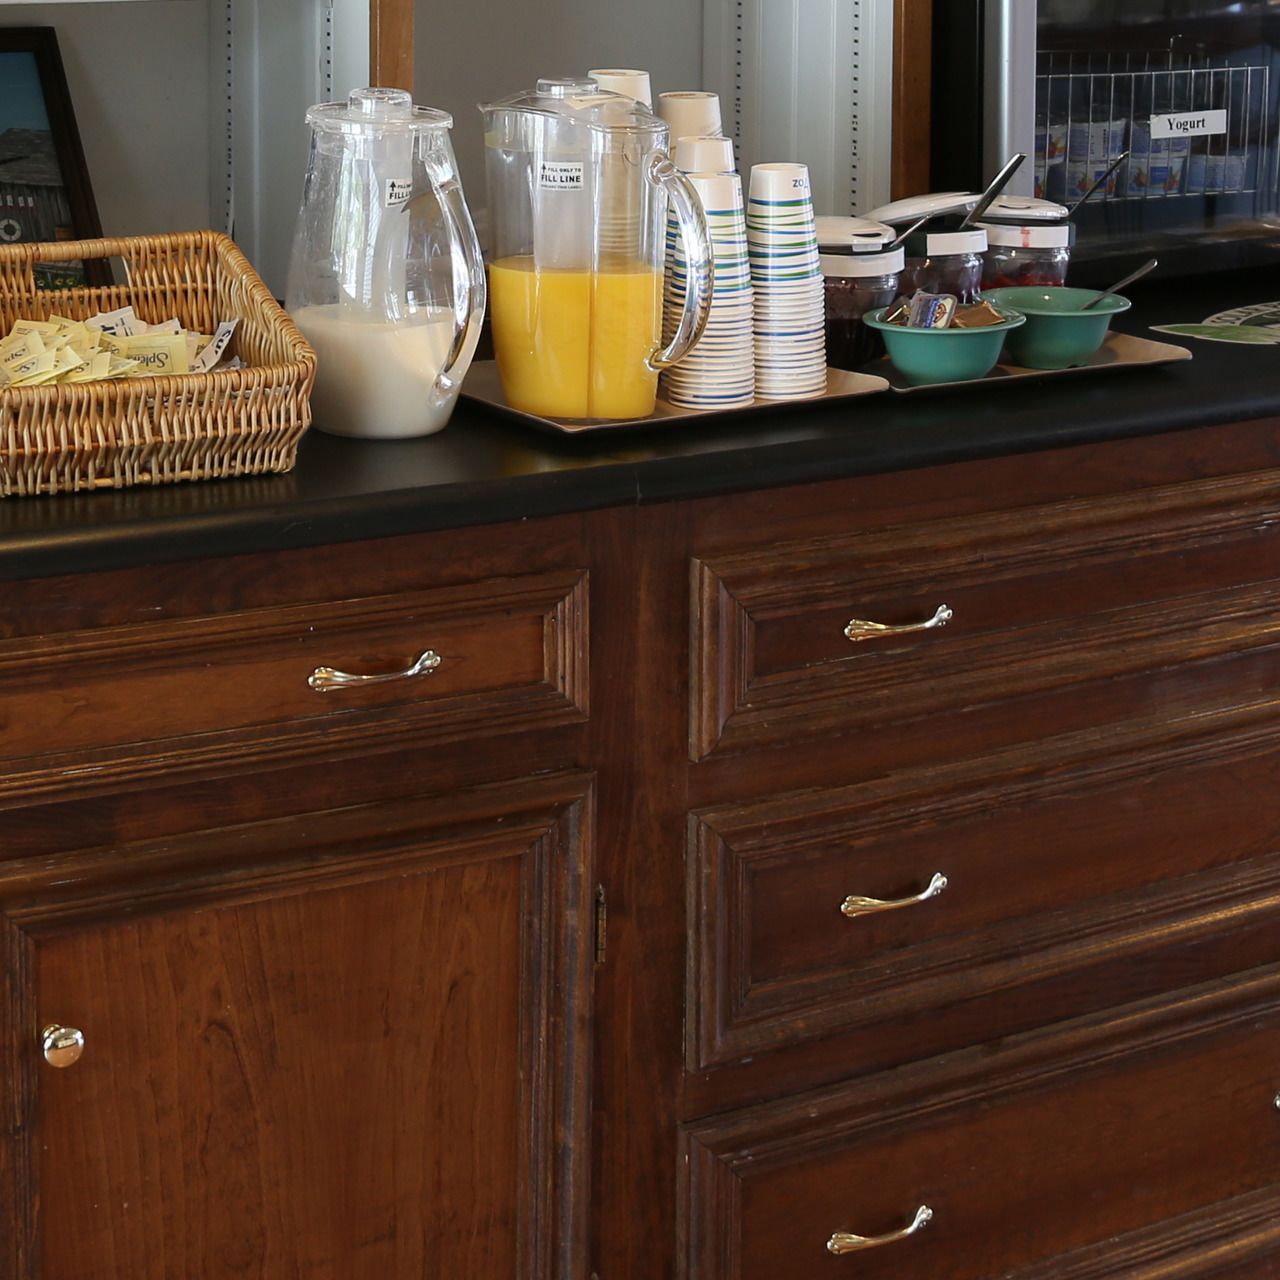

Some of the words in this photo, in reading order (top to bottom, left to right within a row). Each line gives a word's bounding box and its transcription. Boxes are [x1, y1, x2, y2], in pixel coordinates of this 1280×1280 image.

[1167, 117, 1207, 133] Yogurt
[541, 174, 557, 183] FILL
[560, 175, 581, 183] LINE
